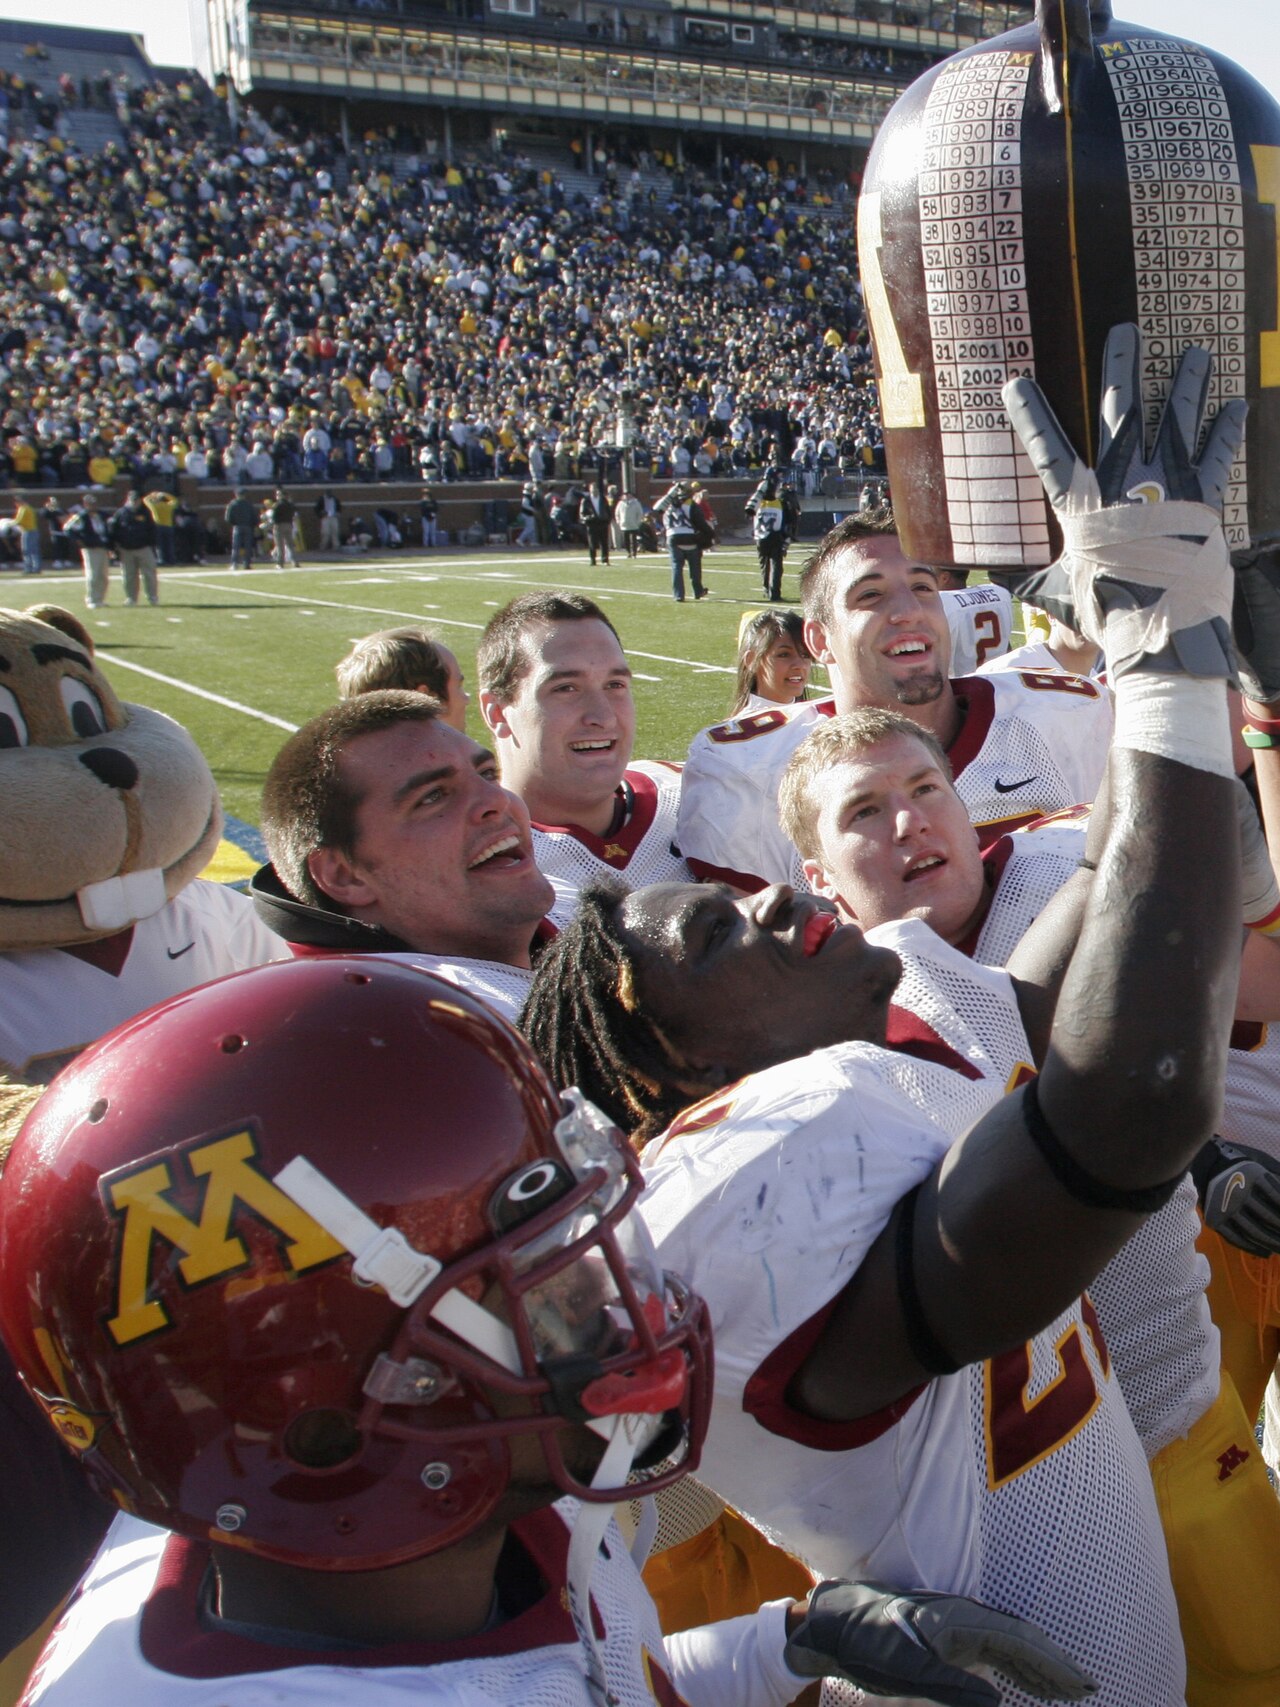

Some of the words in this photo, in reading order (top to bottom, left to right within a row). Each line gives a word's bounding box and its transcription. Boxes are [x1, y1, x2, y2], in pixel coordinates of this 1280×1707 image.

[1101, 41, 1127, 57] M
[1130, 41, 1180, 50] YEAR
[965, 53, 1008, 67] YEAR
[1007, 53, 1034, 65] M
[1113, 59, 1130, 69] 0
[1141, 55, 1185, 66] 1963
[1193, 57, 1207, 68] 6
[959, 68, 1000, 84] 1987
[1006, 69, 1024, 78] 20
[1116, 72, 1137, 86] 19
[1147, 69, 1191, 81] 1964
[1197, 71, 1219, 84] 12
[953, 82, 994, 100] 1988
[1005, 86, 1017, 98] 7
[1120, 87, 1140, 101] 13
[1149, 85, 1196, 97] 1965
[1202, 86, 1221, 98] 14
[948, 100, 988, 120] 1989
[998, 103, 1016, 117] 15
[1121, 103, 1147, 119] 49
[1153, 101, 1199, 116] 1966
[1209, 102, 1222, 117] 0
[945, 123, 985, 142] 1990
[998, 123, 1015, 137] 18
[1128, 122, 1147, 138] 15
[1158, 121, 1201, 137] 1967
[1209, 122, 1228, 138] 20
[943, 146, 984, 166] 1991
[1001, 146, 1010, 160] 6
[1128, 143, 1153, 160] 33
[1161, 142, 1204, 158] 1968
[1212, 143, 1232, 160] 20
[943, 171, 987, 190] 1992
[998, 170, 1015, 185] 13
[1130, 164, 1155, 179] 35
[1164, 162, 1205, 178] 1969
[1219, 164, 1230, 180] 9
[1134, 184, 1160, 200] 39
[1168, 184, 1212, 199] 1970
[1221, 186, 1235, 201] 13
[923, 199, 937, 216] 58
[944, 195, 987, 214] 1993
[999, 192, 1011, 208] 7
[1136, 206, 1159, 223] 35
[1170, 206, 1205, 222] 1971
[1224, 208, 1234, 223] 7
[925, 224, 938, 240] 38
[946, 221, 988, 241] 1994
[997, 221, 1016, 235] 22
[1136, 229, 1163, 247] 42
[1172, 230, 1210, 245] 1972
[1224, 230, 1239, 246] 0
[926, 250, 942, 266] 52
[948, 245, 990, 266] 1995
[1001, 244, 1018, 260] 17
[1140, 252, 1164, 268] 34
[1173, 250, 1214, 267] 1973
[1226, 253, 1237, 267] 7
[929, 273, 944, 288] 44
[950, 269, 991, 289] 1996
[1002, 269, 1020, 285] 10
[1138, 273, 1162, 288] 49
[1174, 273, 1211, 288] 1974
[1224, 274, 1237, 287] 0
[931, 298, 947, 312] 24
[953, 294, 994, 313] 1997
[1008, 295, 1020, 312] 3
[1142, 295, 1166, 312] 28
[1175, 294, 1213, 311] 1975
[1223, 294, 1238, 310] 21
[934, 320, 948, 336] 15
[955, 317, 997, 337] 1998
[1006, 317, 1023, 331] 10
[1143, 318, 1166, 334] 45
[1176, 318, 1215, 333] 1976
[1225, 317, 1238, 330] 0
[936, 344, 953, 360] 31
[958, 344, 999, 359] 2001
[1008, 341, 1028, 358] 10
[1149, 341, 1164, 356] 0
[1223, 338, 1238, 353] 16
[1145, 361, 1169, 377] 42
[1224, 358, 1240, 372] 10
[938, 371, 954, 387] 41
[962, 369, 1003, 386] 2002
[1149, 382, 1165, 397] 31
[1224, 379, 1238, 392] 21
[941, 394, 958, 408] 38
[963, 393, 1004, 407] 2003
[942, 415, 958, 432] 27
[965, 413, 1009, 429] 2004
[1231, 488, 1239, 500] 7
[1232, 509, 1239, 521] 7
[1229, 528, 1245, 543] 20
[953, 588, 1001, 608] D.JONES
[973, 610, 1002, 669] 2
[107, 1130, 352, 1346] M
